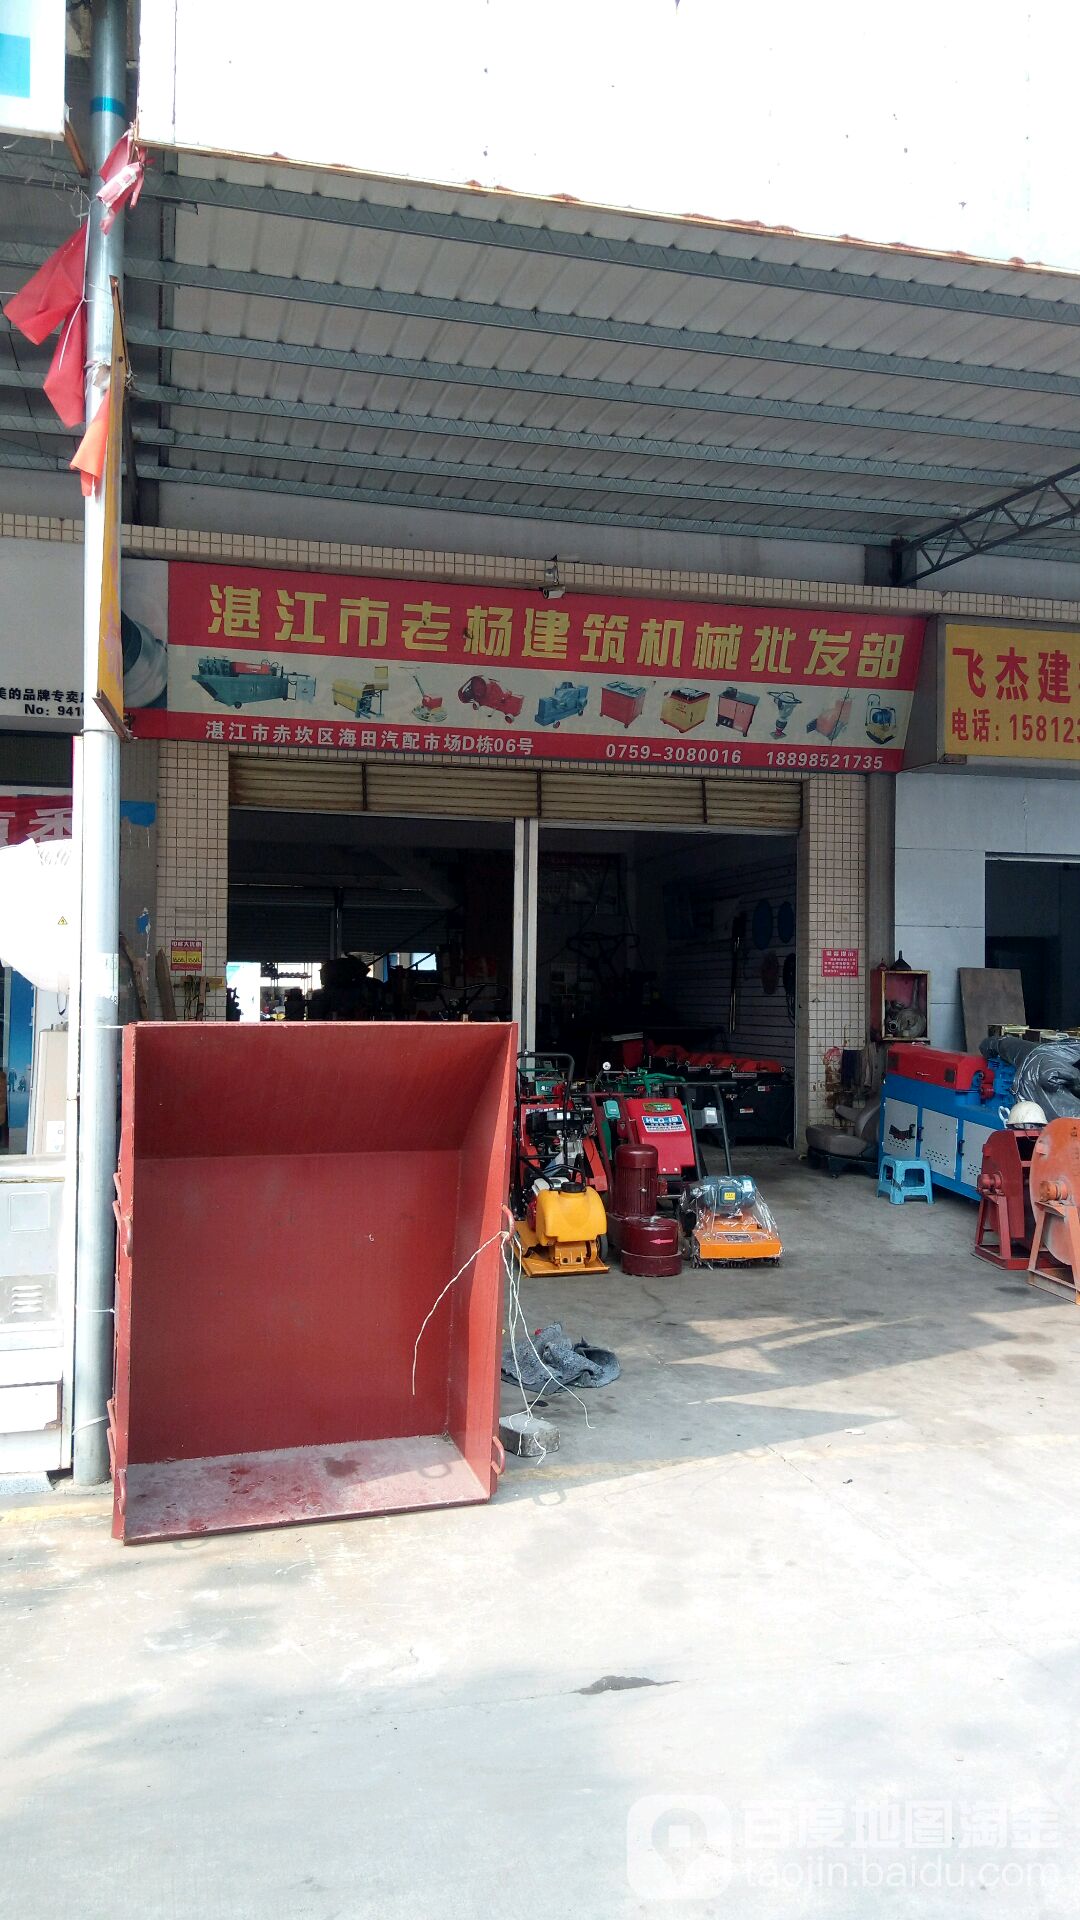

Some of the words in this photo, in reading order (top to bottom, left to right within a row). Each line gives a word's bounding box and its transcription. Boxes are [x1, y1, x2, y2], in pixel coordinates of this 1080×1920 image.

[207, 584, 906, 680] 湛江市老杨建筑机械批发部
[952, 646, 1080, 704] 飞杰建
[205, 720, 535, 756] 湛江市赤坎区海田汽配市场D栋06号
[605, 743, 743, 765] 0759-3080016
[766, 751, 885, 770] 18898521735
